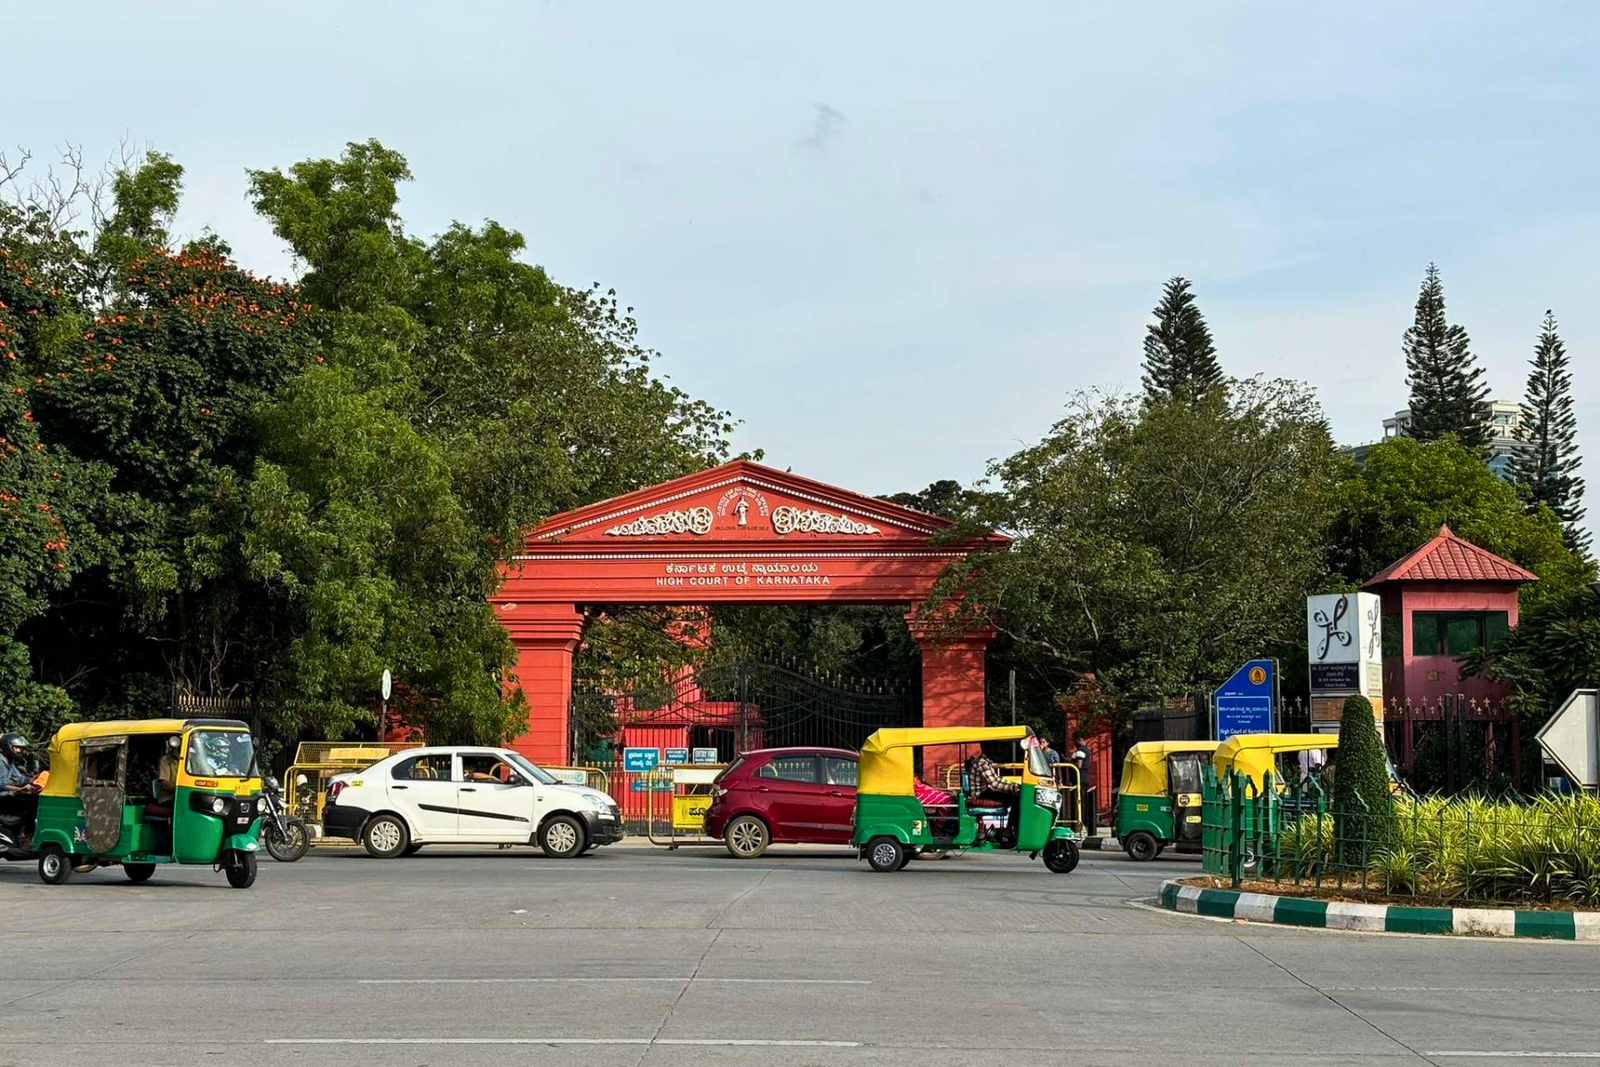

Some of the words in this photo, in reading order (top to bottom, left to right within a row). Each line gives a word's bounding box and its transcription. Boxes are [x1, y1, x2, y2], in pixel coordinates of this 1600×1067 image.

[665, 563, 716, 573] ಕರ್ನಾಟಕ
[656, 577, 683, 586] HIGH
[689, 577, 728, 586] COURT
[735, 576, 750, 585] OF
[756, 576, 830, 585] KARNATAKA
